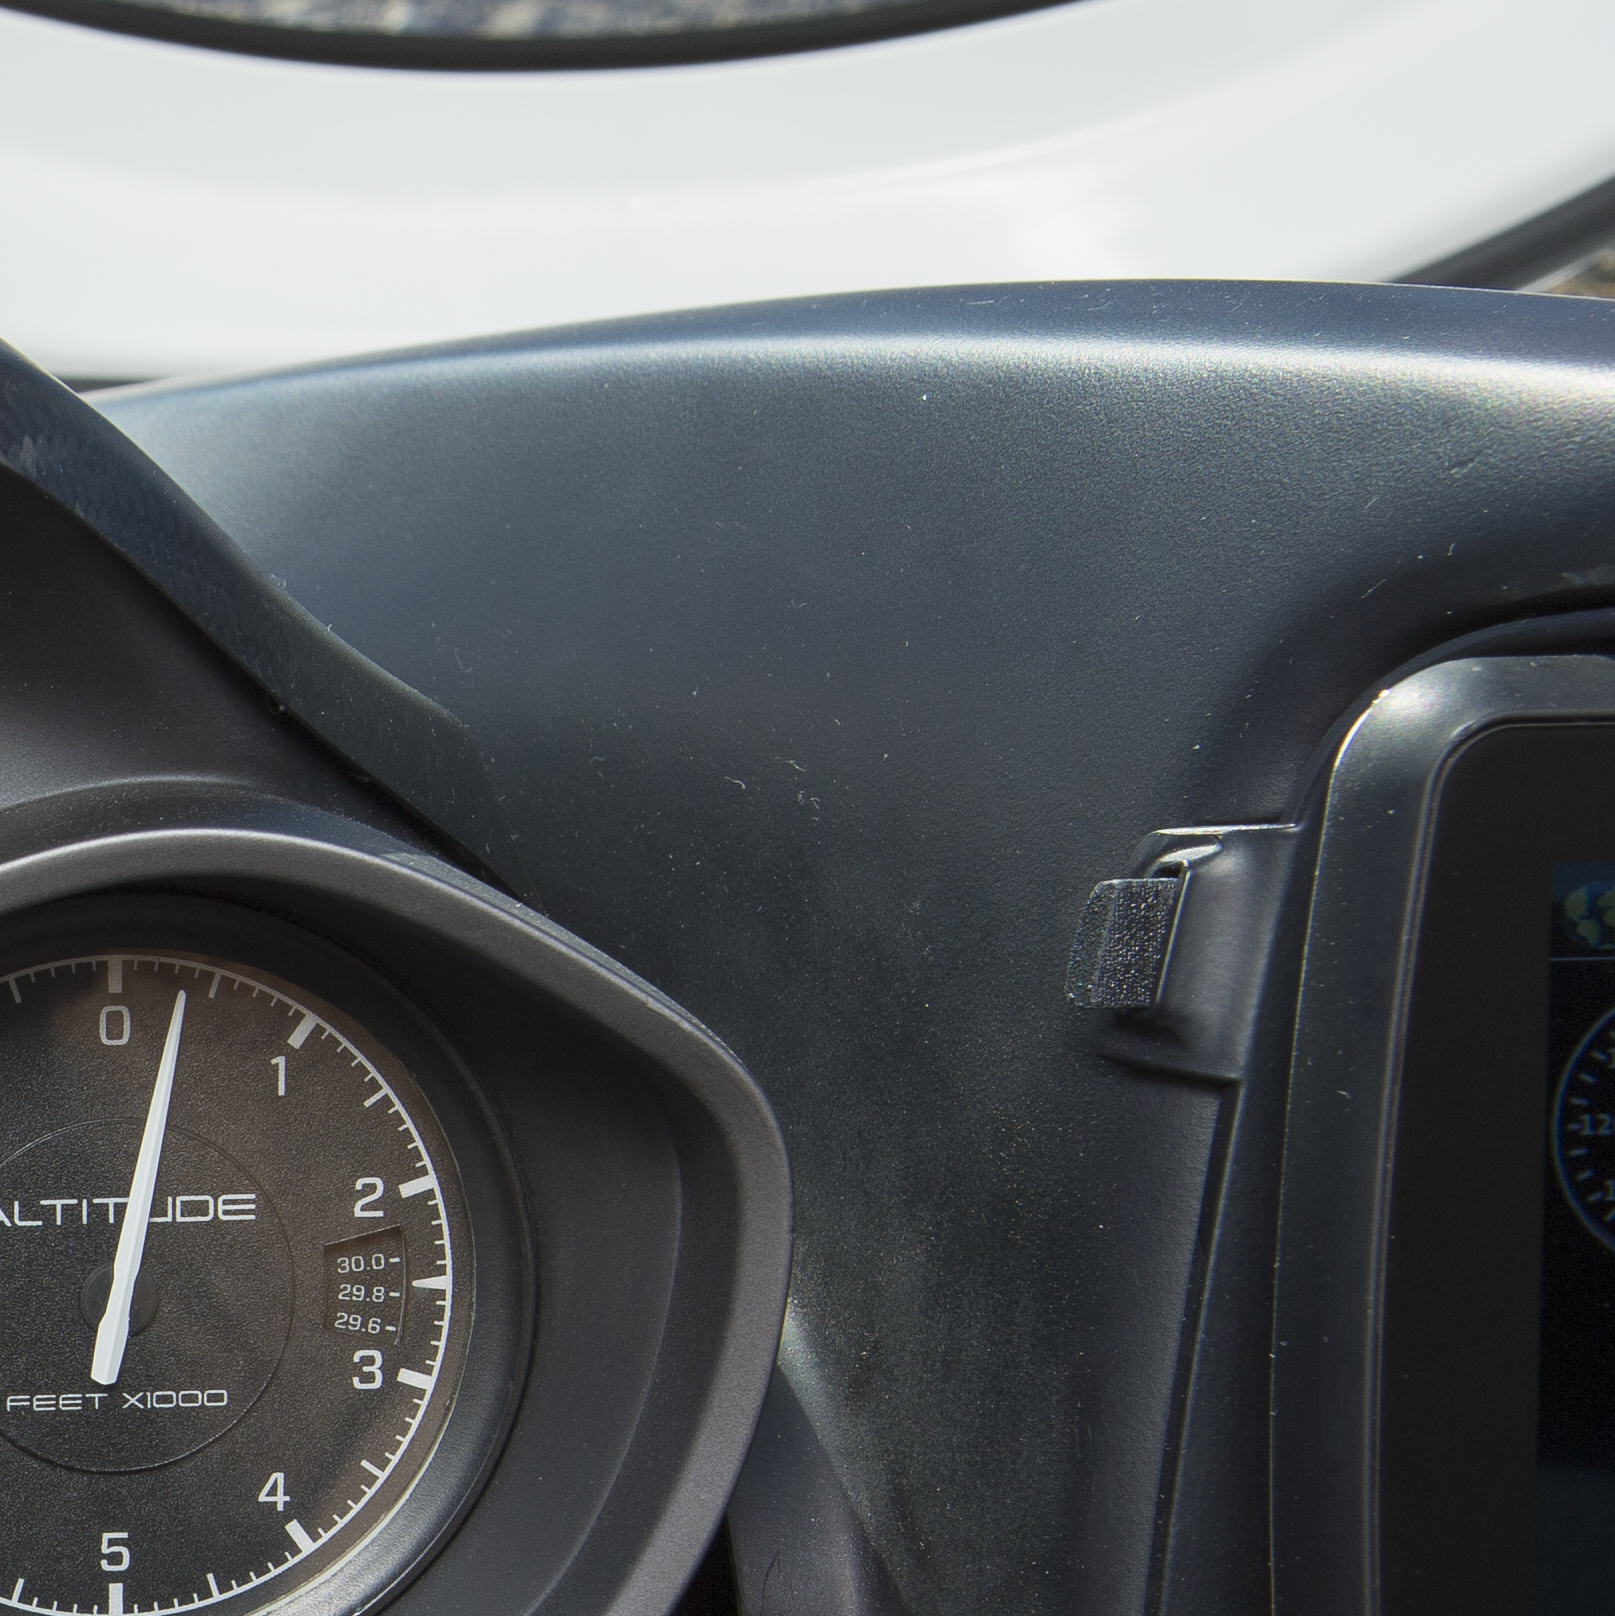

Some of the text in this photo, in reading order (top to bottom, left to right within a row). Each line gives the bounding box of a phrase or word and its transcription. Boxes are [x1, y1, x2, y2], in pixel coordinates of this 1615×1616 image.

[99, 1005, 131, 1046] 0
[270, 1056, 288, 1096] 1
[353, 1177, 385, 1218] 2
[336, 1253, 385, 1274] 30.0
[337, 1283, 385, 1303] 29.8
[334, 1312, 382, 1334] 29.6
[352, 1350, 384, 1390] 3
[5, 1389, 228, 1412] FEET X1000
[257, 1471, 291, 1512] 4
[99, 1531, 131, 1573] 5
